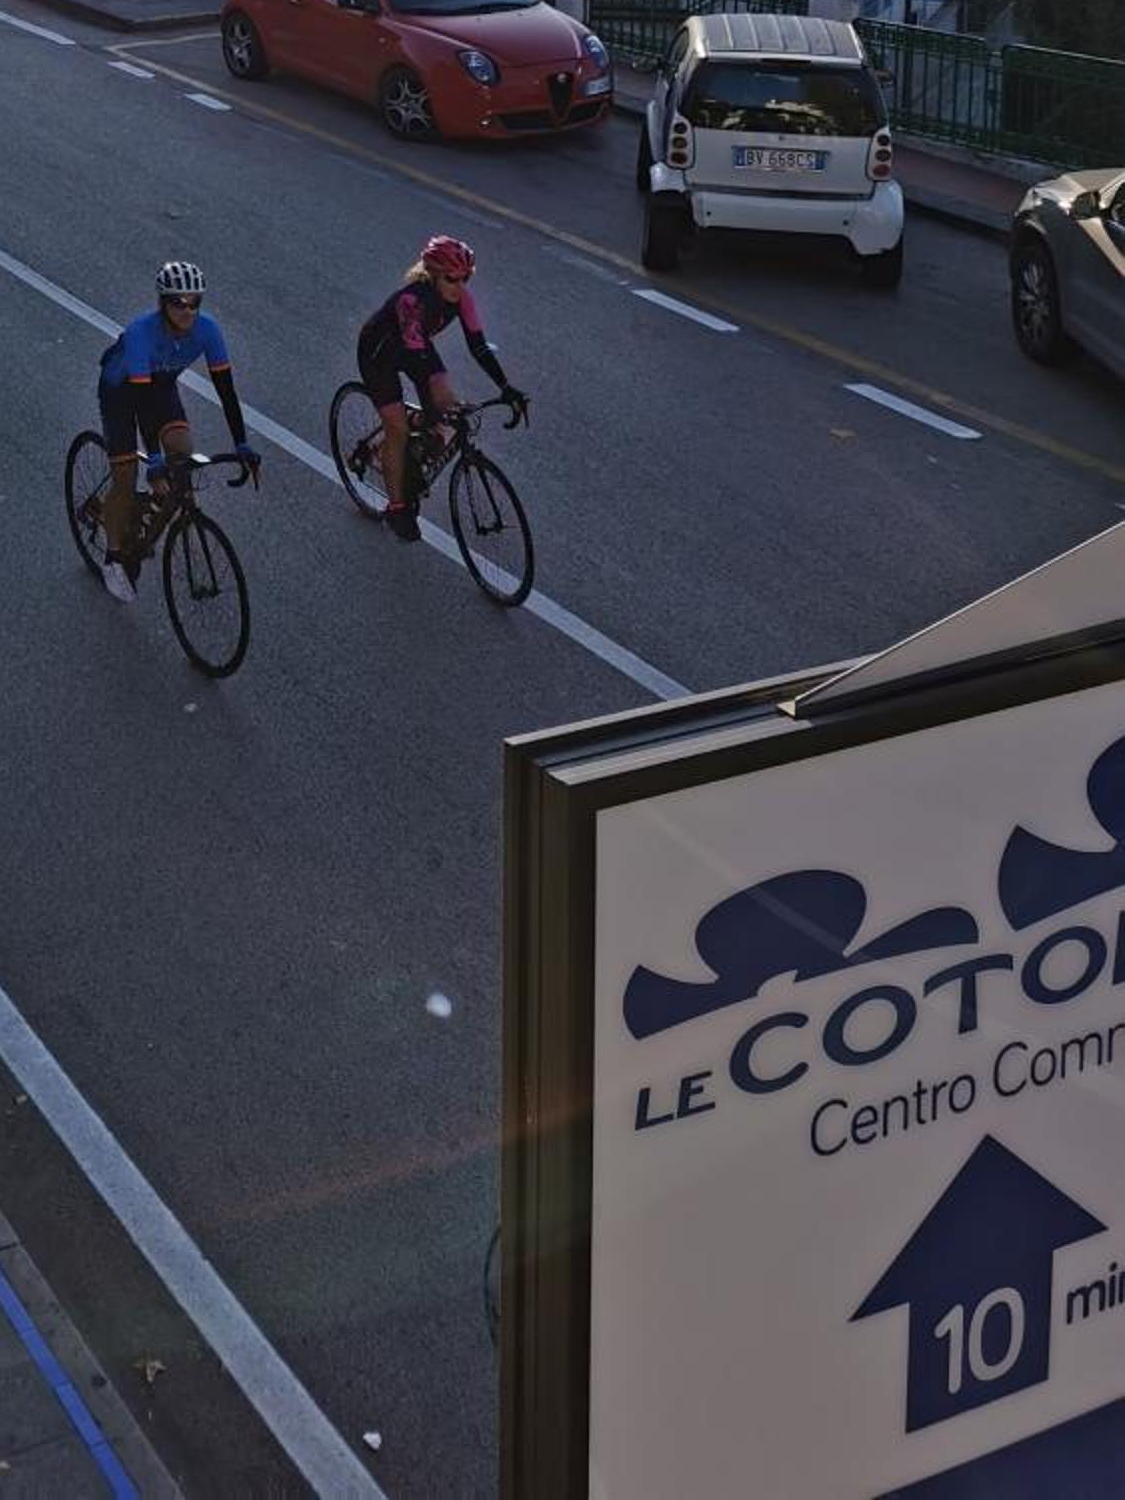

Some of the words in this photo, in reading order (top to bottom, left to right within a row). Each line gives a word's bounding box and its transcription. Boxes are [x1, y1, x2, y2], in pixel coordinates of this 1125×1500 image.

[634, 1070, 716, 1130] LE
[810, 1075, 976, 1156] Centro
[934, 1287, 1025, 1395] 10
[1066, 1261, 1125, 1325] mi
